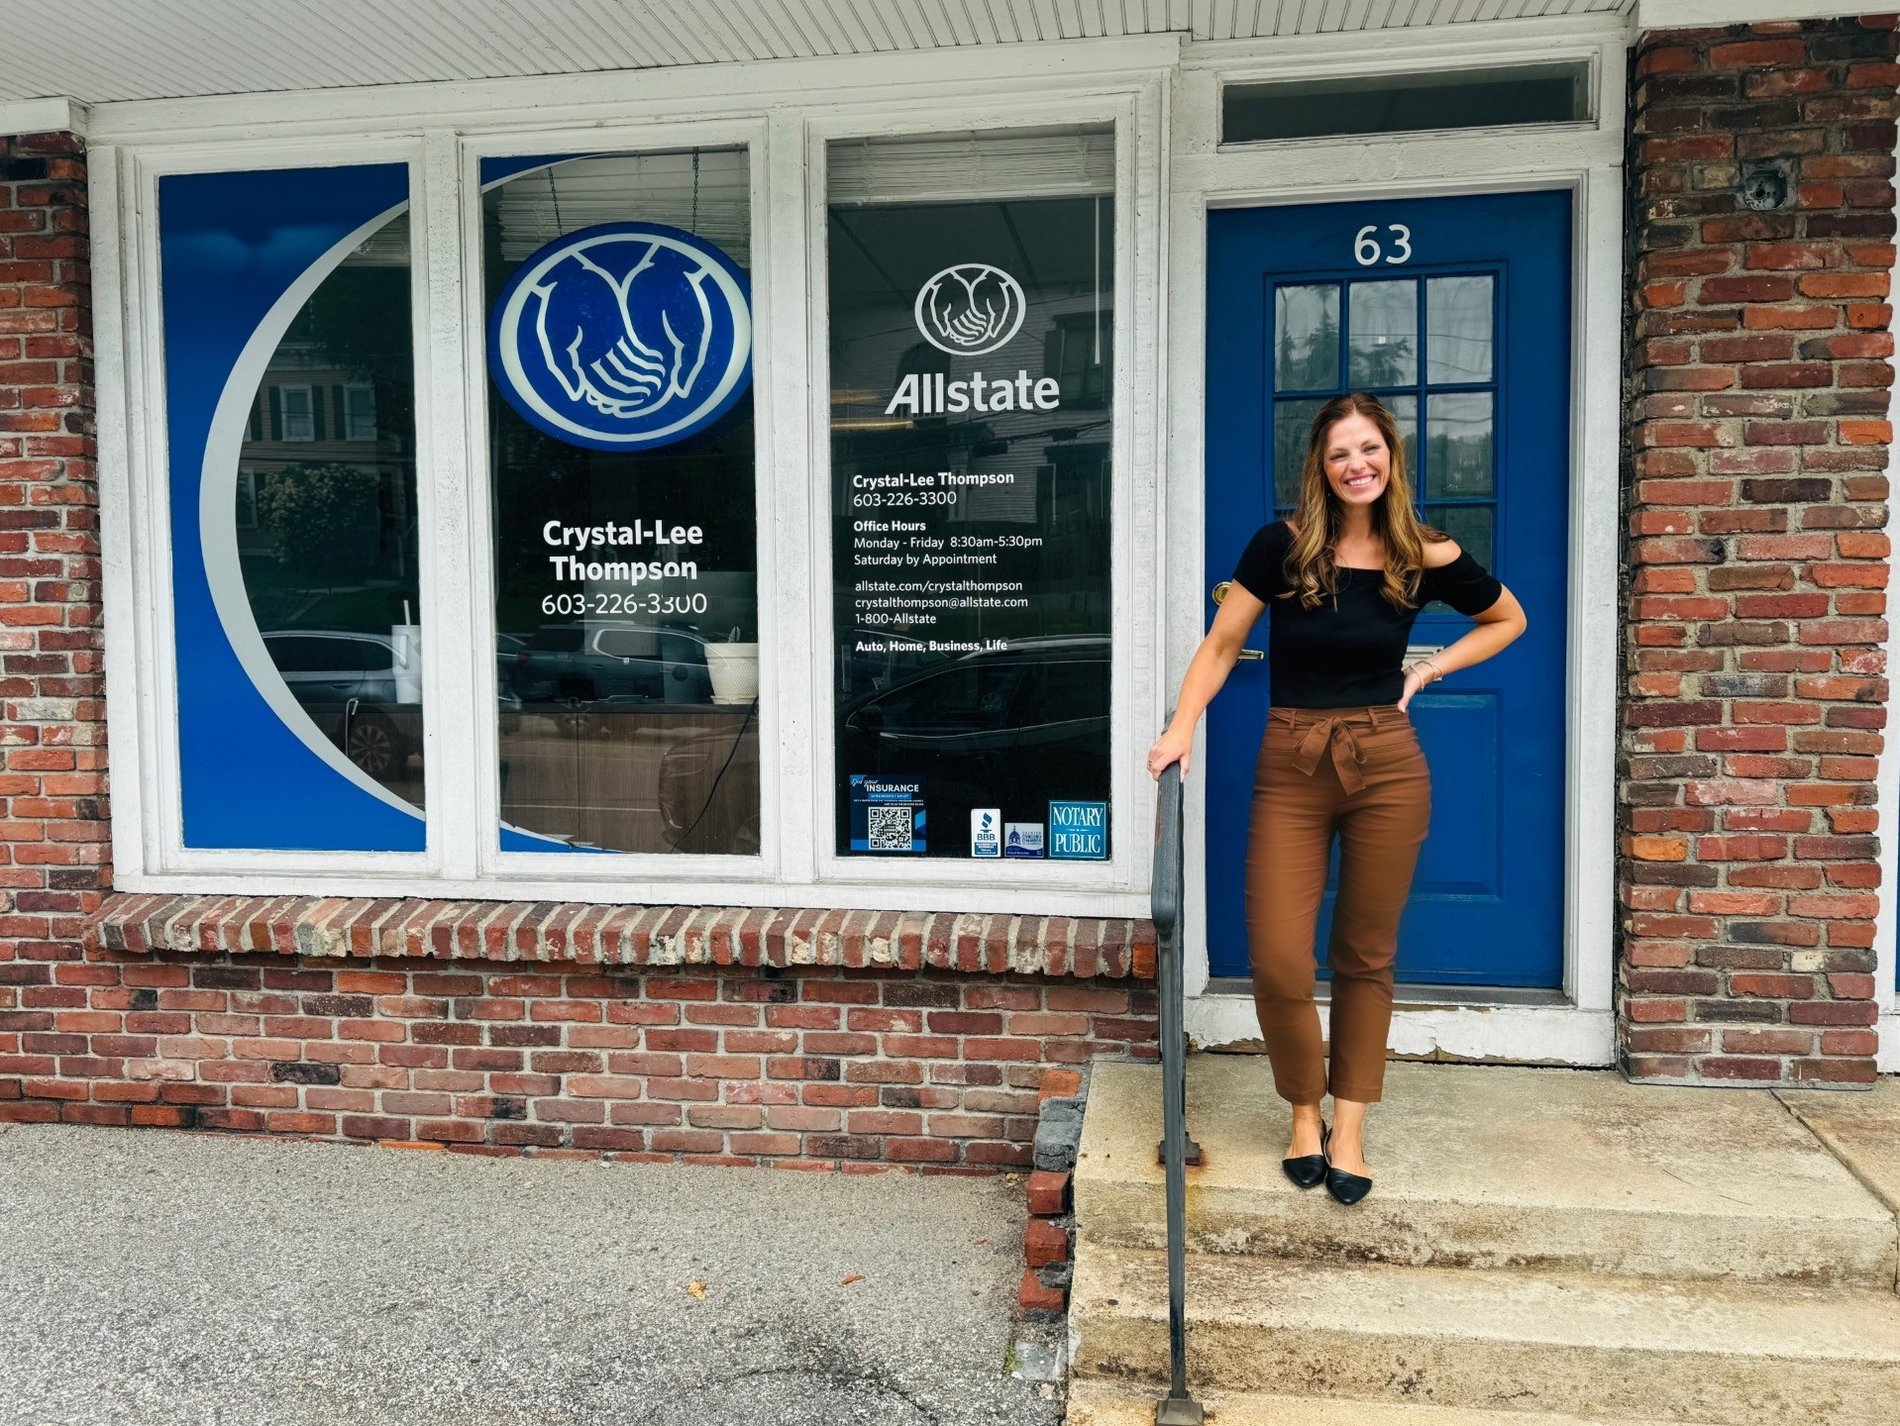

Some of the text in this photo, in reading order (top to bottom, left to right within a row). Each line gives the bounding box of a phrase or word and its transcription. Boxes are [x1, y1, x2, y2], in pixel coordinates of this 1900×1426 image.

[1354, 223, 1412, 266] 63
[884, 369, 1060, 415] Allstate
[852, 472, 1015, 490] Crystal-Lee Thompson
[853, 491, 957, 507] 603-226-3300
[853, 520, 927, 532] Office Hours
[542, 518, 703, 551] Crystal-Lee
[854, 537, 900, 550] Monday
[910, 536, 945, 550] Friday
[949, 535, 1043, 549] 8:30am-5:30pm
[854, 553, 998, 567] Saturday by Appointment
[549, 554, 698, 586] Thompson
[855, 580, 1023, 594] allstate.com/crystalthompson
[541, 593, 708, 614] 603-226-3300
[855, 596, 1029, 610] crystalthompson@allstate.com
[855, 612, 937, 624] 1-800-Allstate
[855, 639, 1008, 653] Auto, Home, Business, Life
[866, 784, 919, 792] INSURANCE
[1052, 806, 1103, 826] NOTARY
[977, 833, 996, 841] BBB
[1055, 833, 1101, 853] PUBLIC
